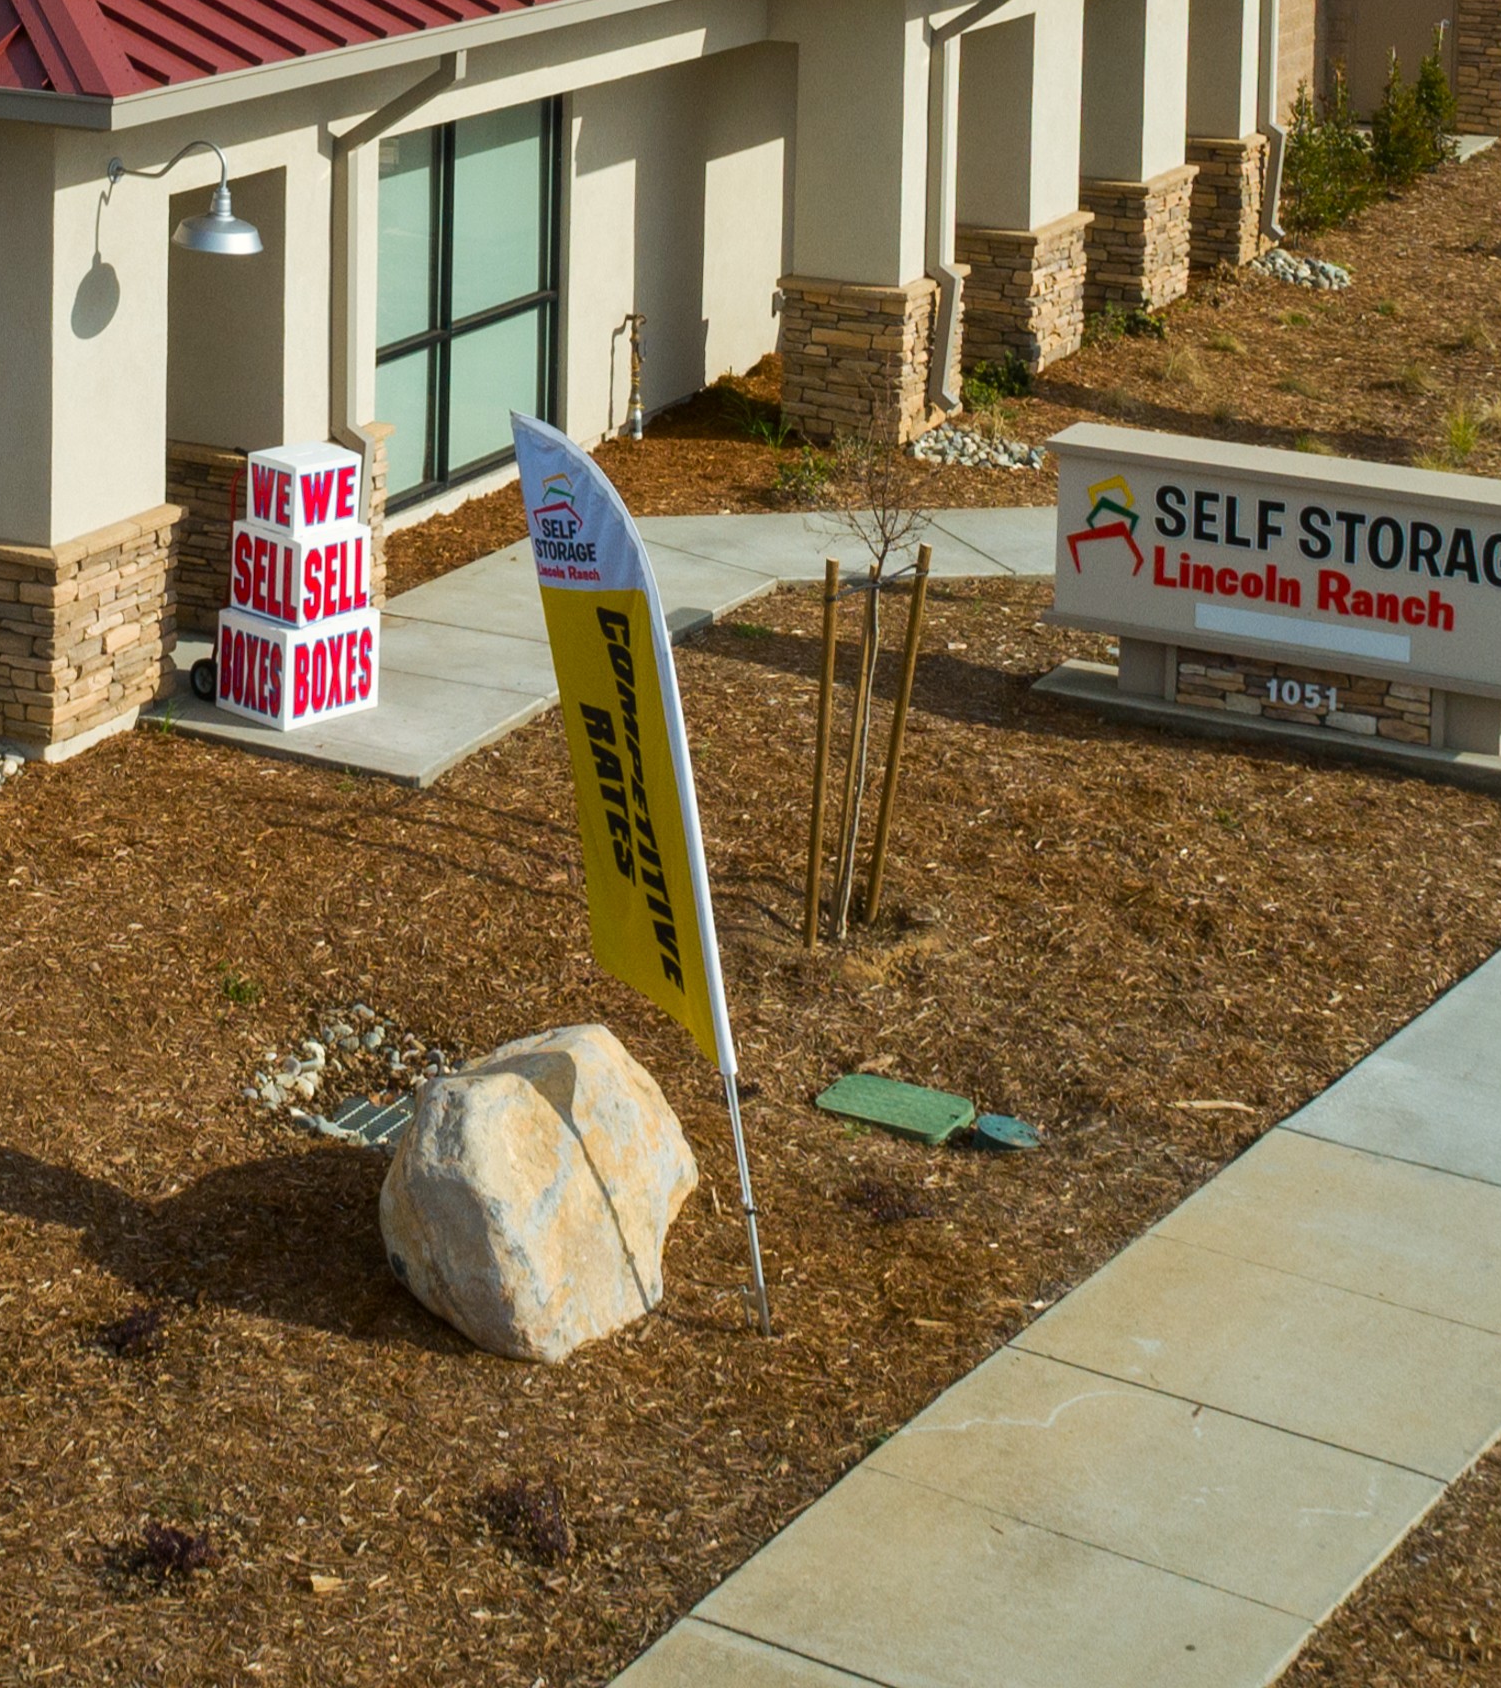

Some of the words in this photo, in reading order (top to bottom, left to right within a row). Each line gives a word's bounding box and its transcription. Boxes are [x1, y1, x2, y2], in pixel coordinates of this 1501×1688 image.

[251, 462, 292, 528] WE
[300, 465, 357, 527] WE
[541, 518, 577, 540] SELF
[1154, 484, 1286, 551] SELF
[234, 532, 297, 622] SELL
[303, 537, 367, 622] SELL
[535, 538, 597, 562] STORAGE
[567, 566, 601, 581] Ranch
[1153, 545, 1301, 608] Lincoln
[1317, 569, 1455, 632] Ranch
[220, 624, 283, 719] BOXES
[293, 626, 372, 719] BOXES
[1266, 677, 1338, 711] 1051
[579, 702, 636, 887] RATES
[596, 607, 685, 995] COMPETITIVE
